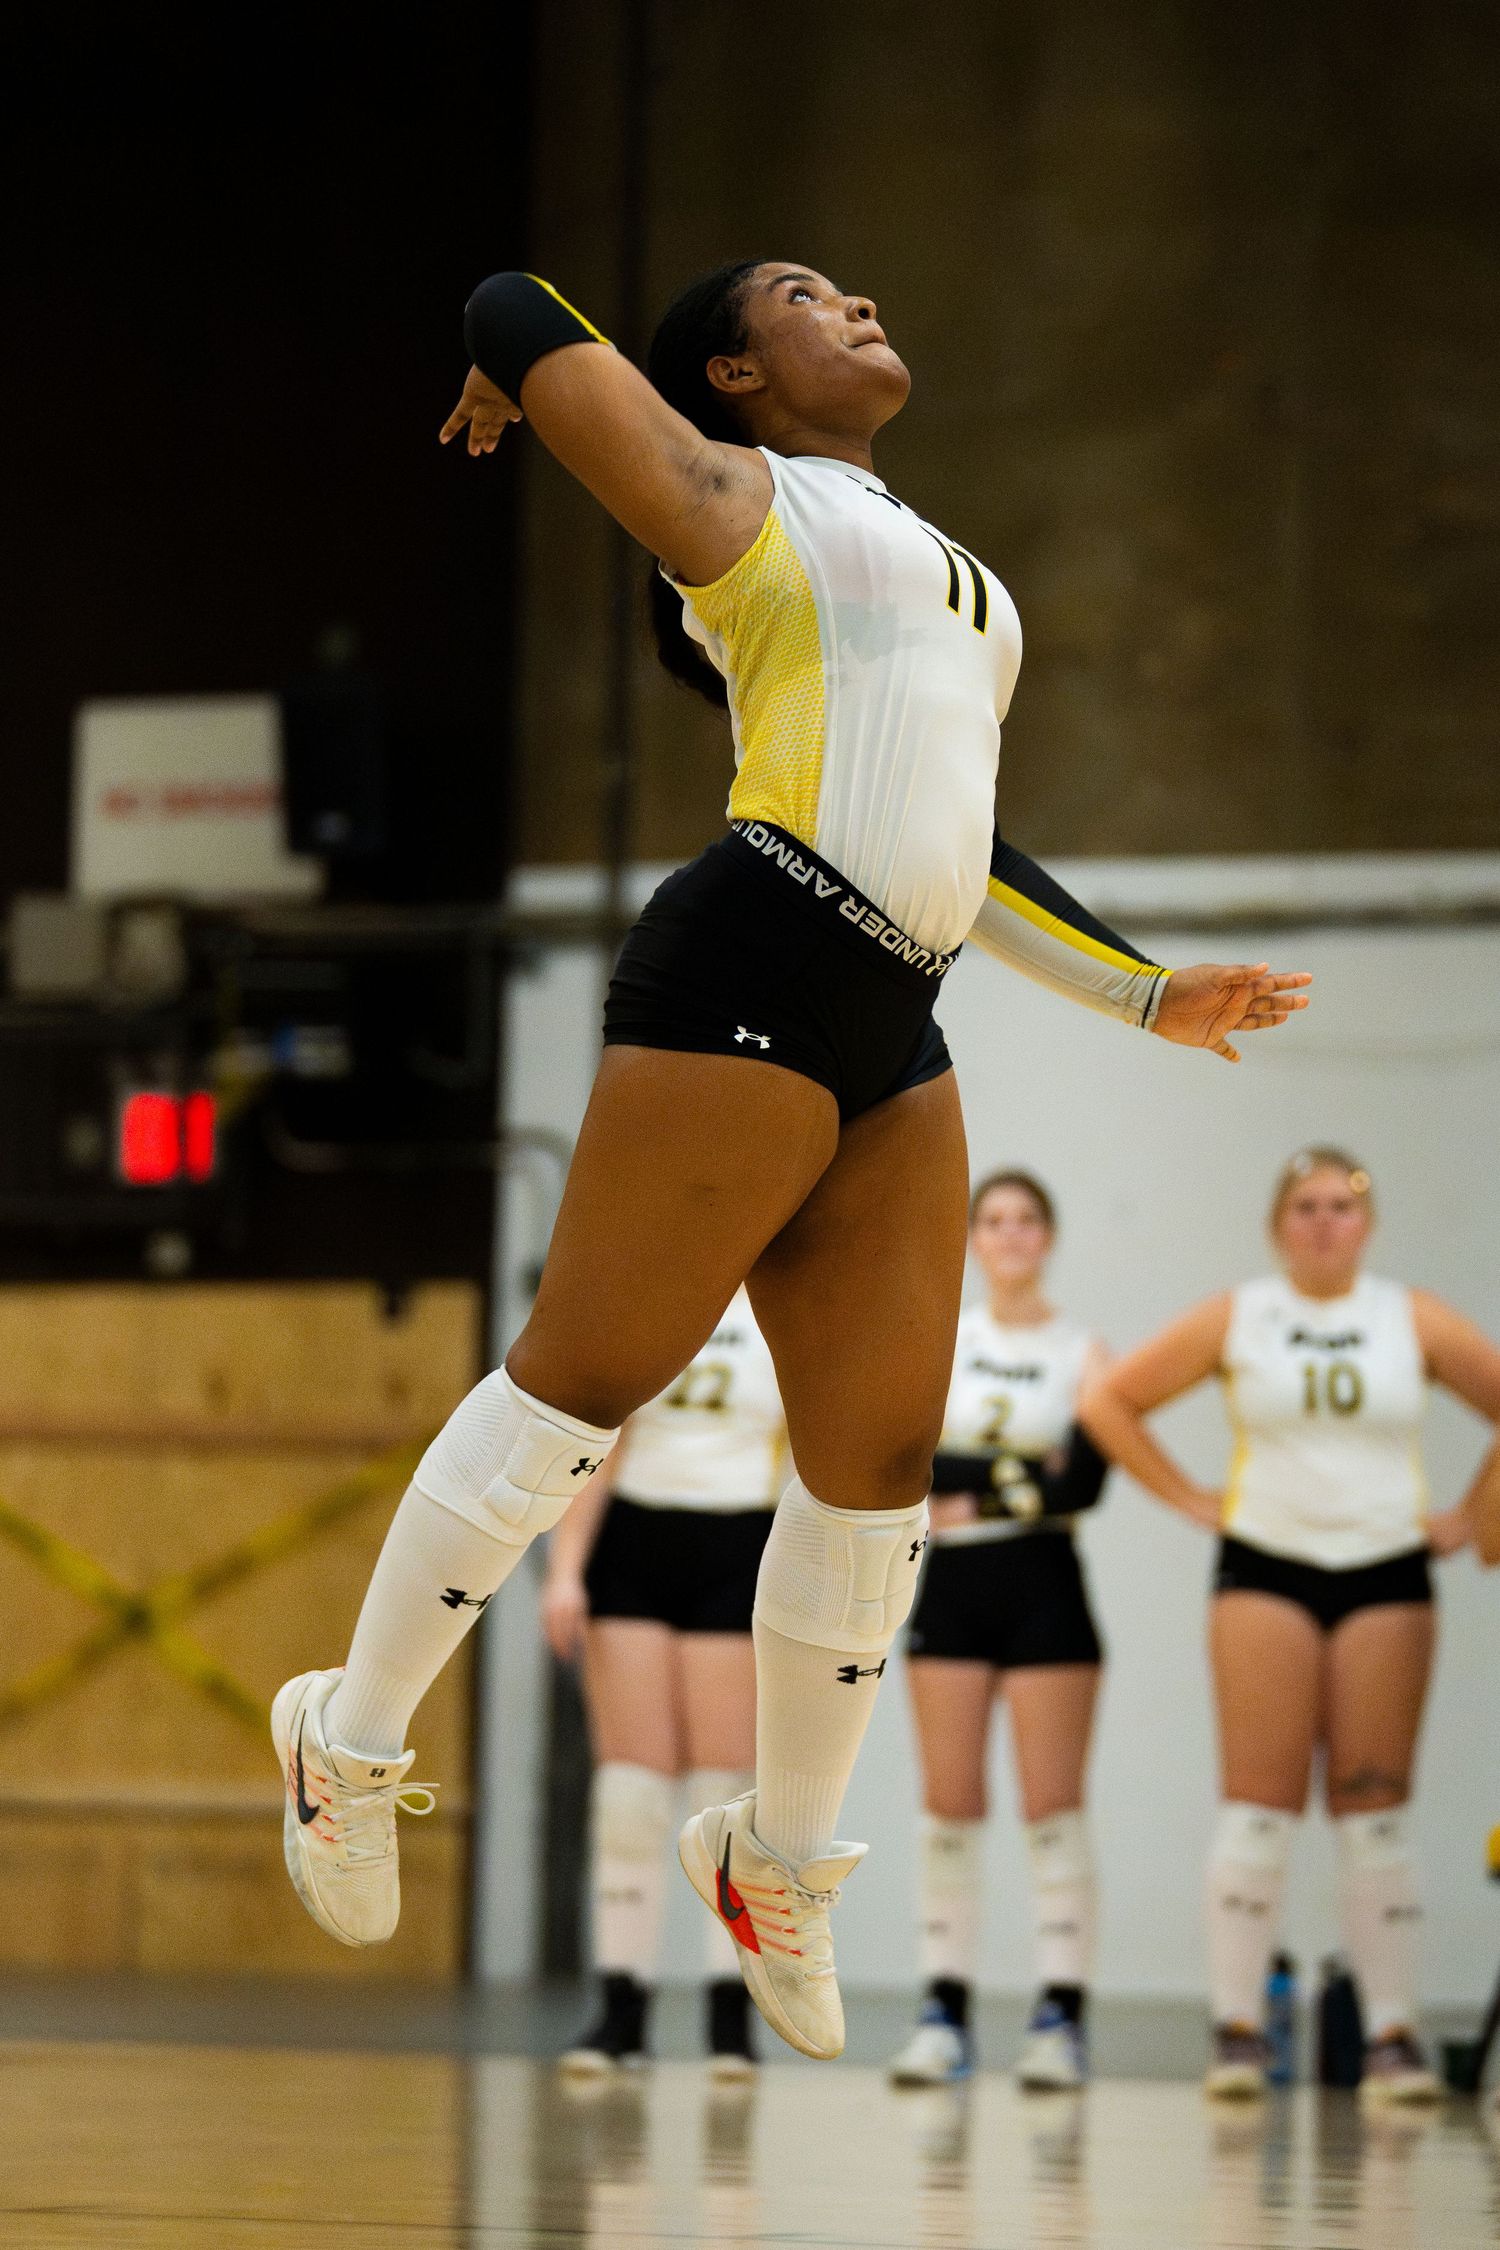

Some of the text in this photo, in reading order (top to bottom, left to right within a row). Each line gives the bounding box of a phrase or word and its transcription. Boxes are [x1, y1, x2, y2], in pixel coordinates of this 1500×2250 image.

[917, 522, 989, 638] 11
[838, 894, 931, 971] UNDER
[1303, 1361, 1366, 1417] 10
